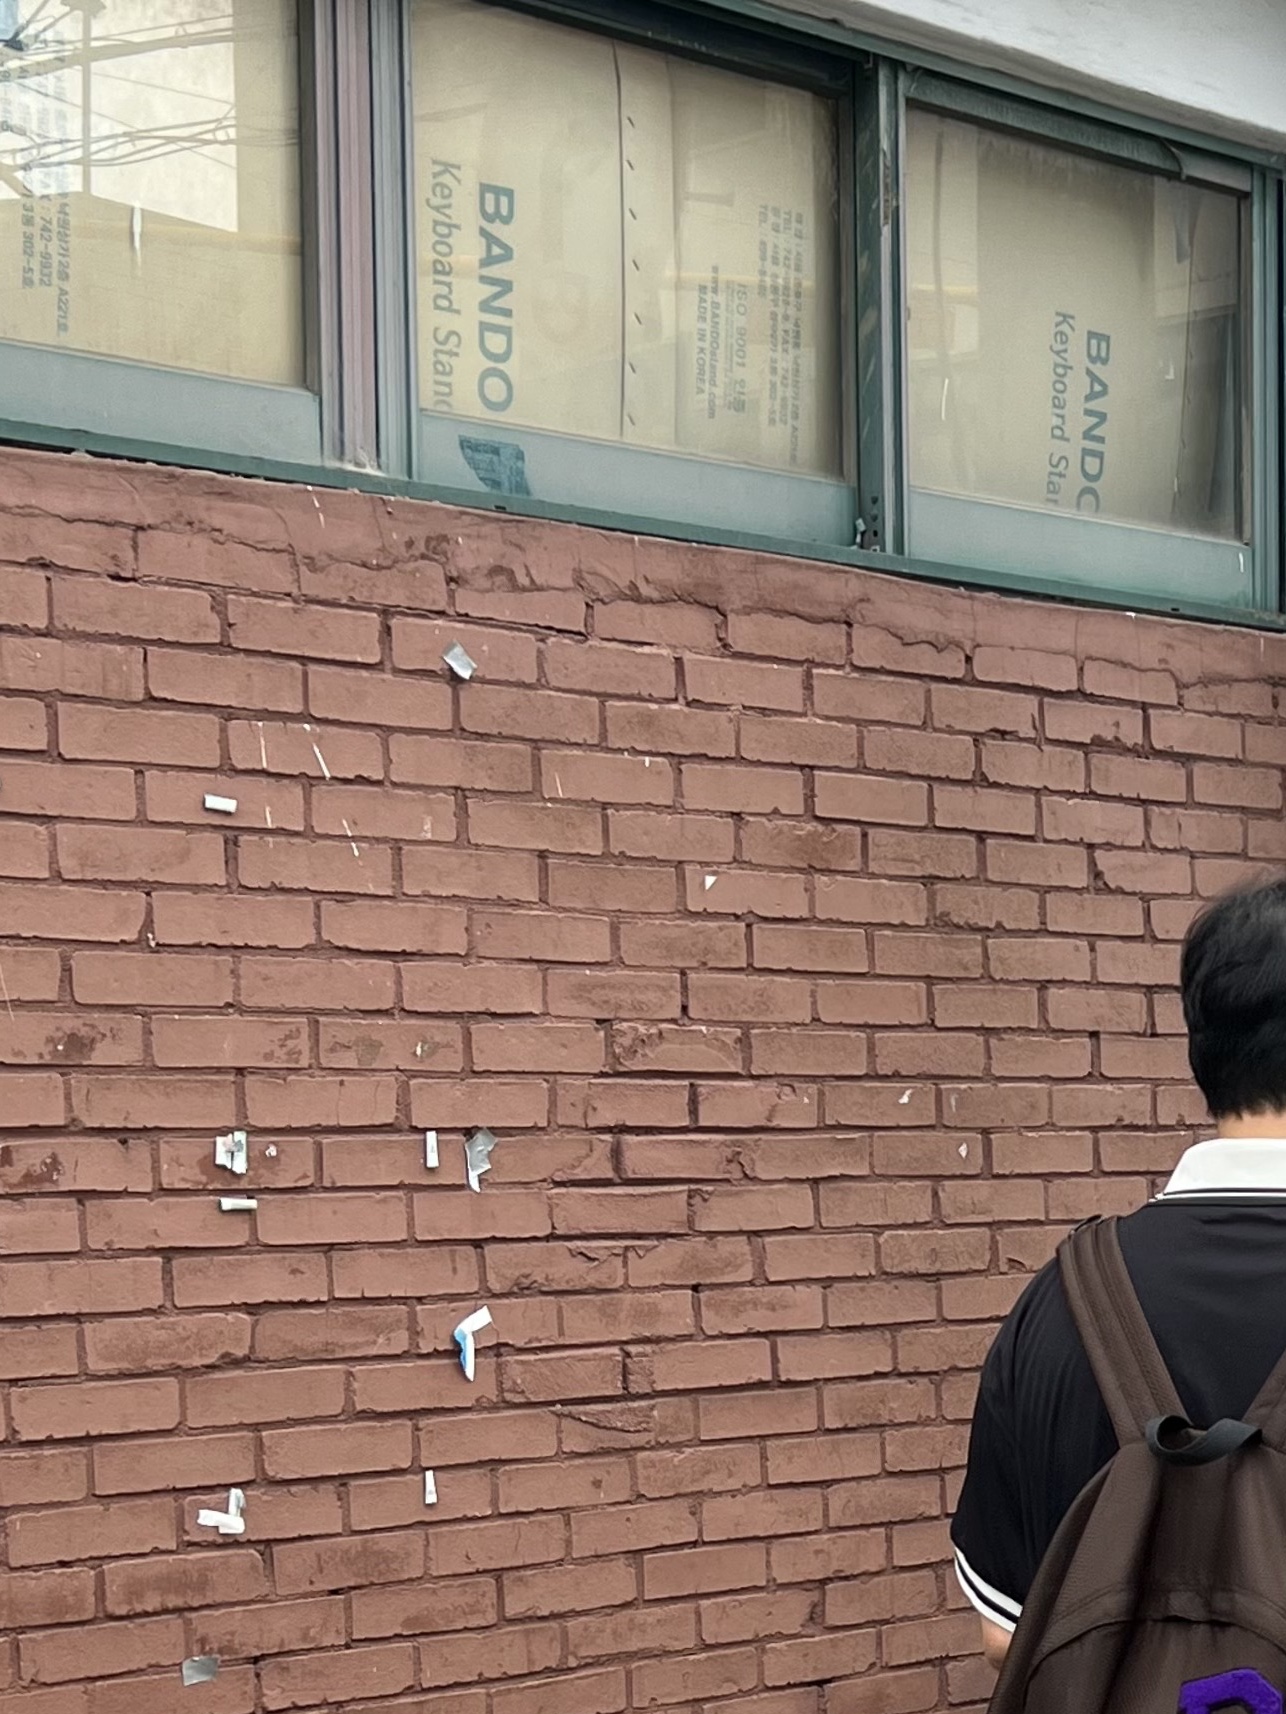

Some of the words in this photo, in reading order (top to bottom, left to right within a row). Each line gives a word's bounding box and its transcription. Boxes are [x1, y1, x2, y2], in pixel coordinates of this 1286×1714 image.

[426, 158, 462, 316] Keyboard
[478, 182, 515, 412] BANDO
[697, 283, 709, 324] MADE
[736, 282, 748, 317] ISO
[697, 327, 708, 343] IN
[735, 326, 748, 369] 9001
[695, 345, 708, 396] KOREA
[1049, 311, 1077, 443] Keyboard
